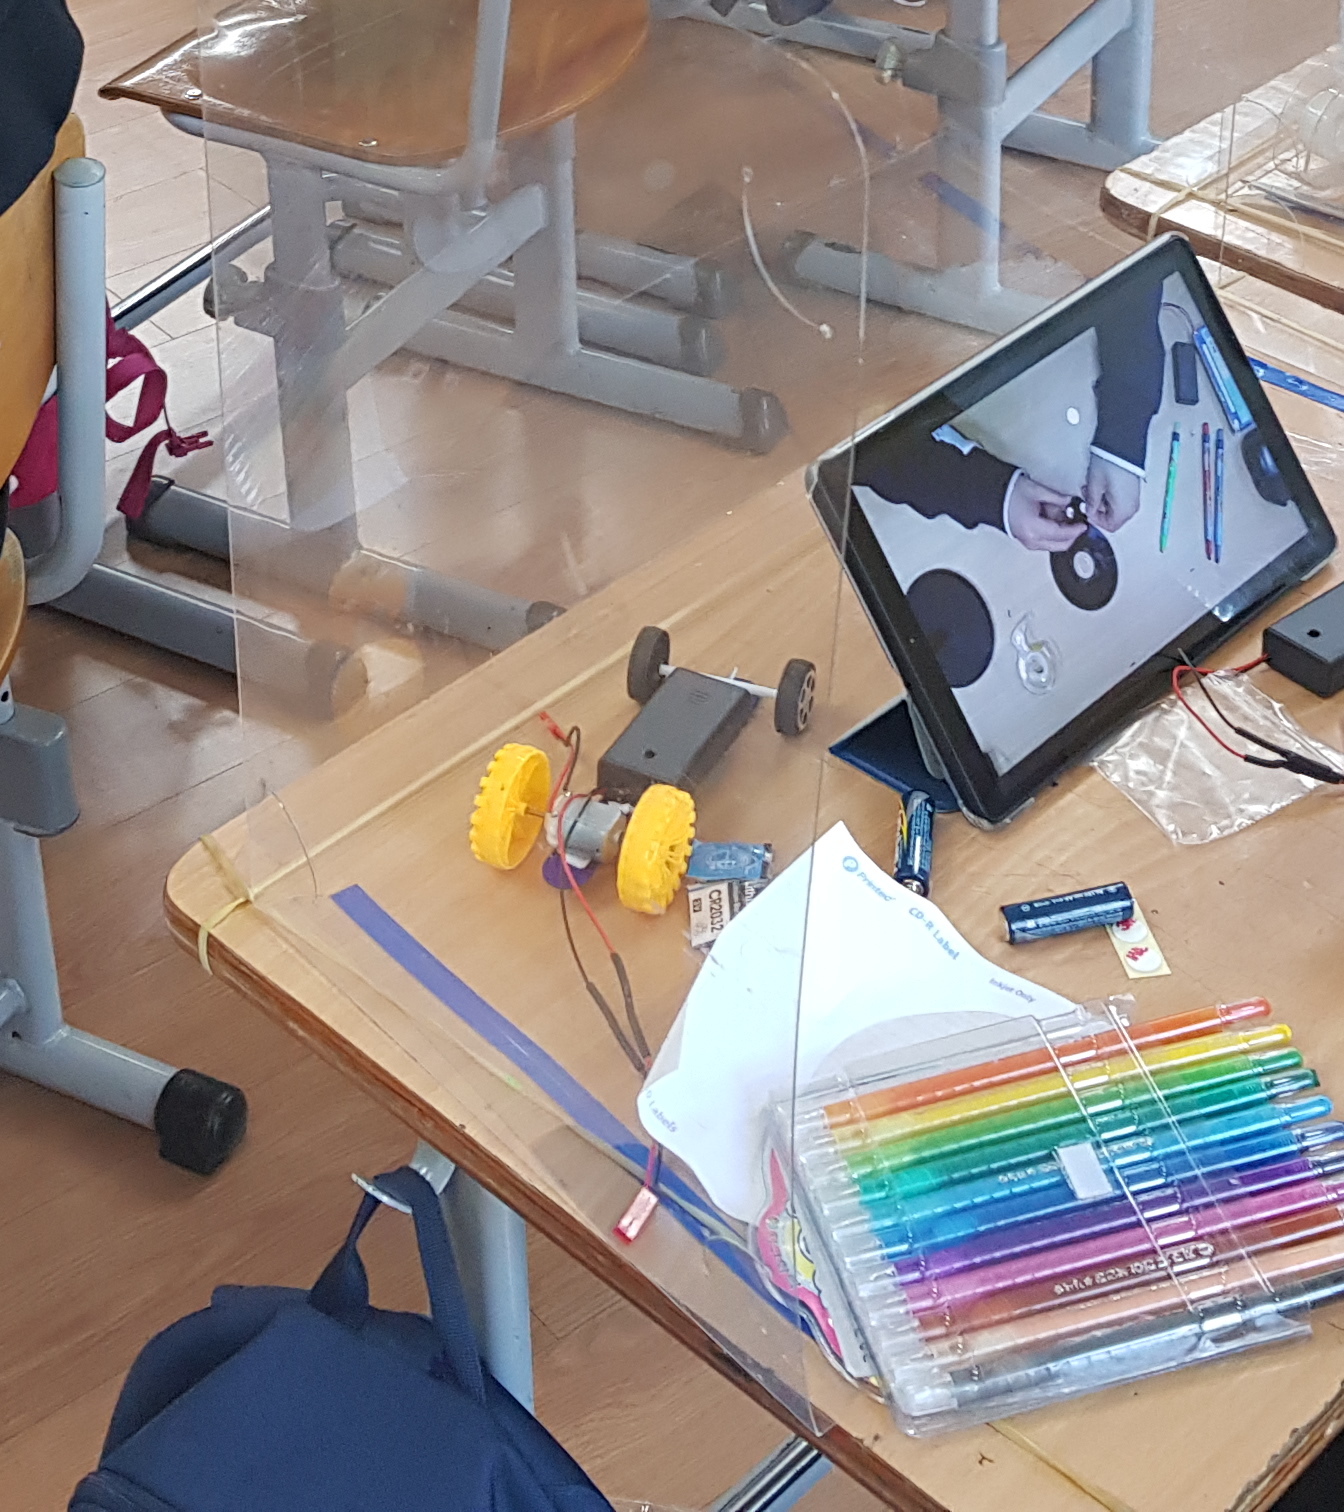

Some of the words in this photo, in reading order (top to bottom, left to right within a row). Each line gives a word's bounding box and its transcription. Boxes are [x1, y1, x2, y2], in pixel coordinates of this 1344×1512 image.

[708, 889, 725, 933] CR2032
[856, 871, 895, 902] Printec
[908, 906, 934, 931] CD-R
[932, 928, 960, 961] Label
[989, 977, 1014, 993] Inkjet
[1015, 989, 1037, 1004] Only
